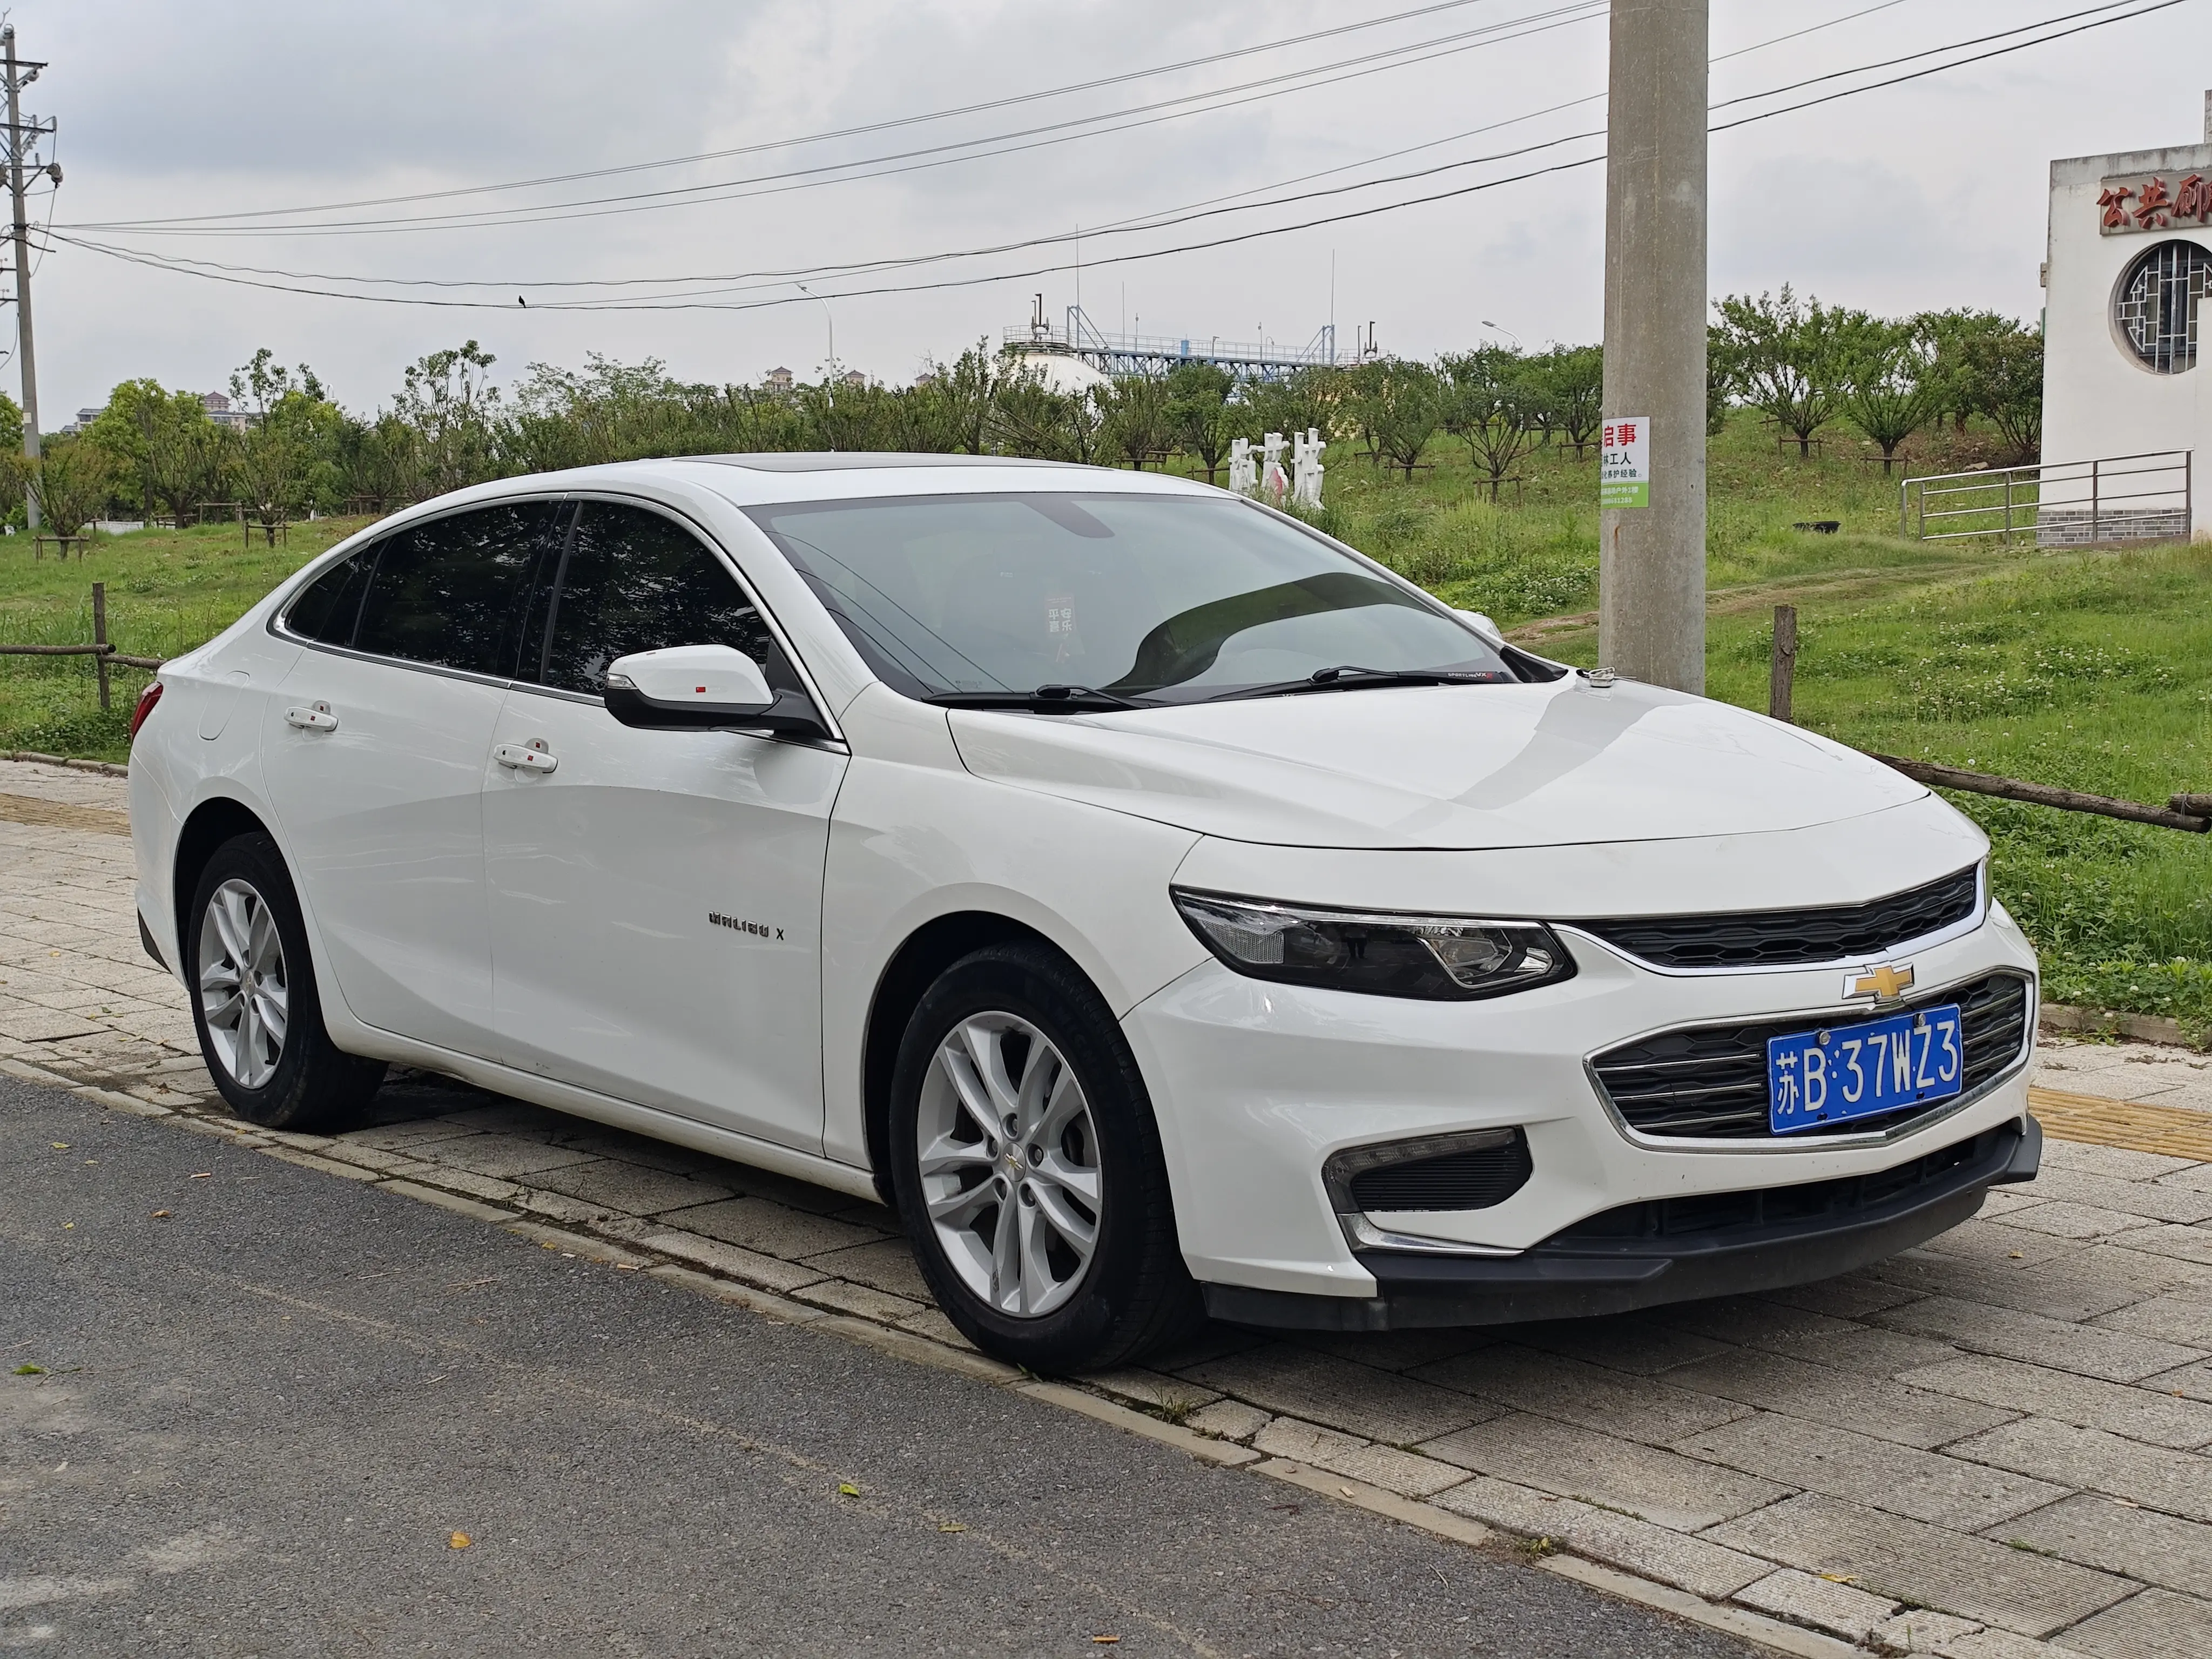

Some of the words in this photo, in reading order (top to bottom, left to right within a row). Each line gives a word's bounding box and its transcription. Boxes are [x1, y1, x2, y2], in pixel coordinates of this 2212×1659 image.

[2096, 173, 2212, 230] 公共厕
[1604, 423, 1636, 447] 启事
[1048, 608, 1072, 620] 平安
[1049, 620, 1073, 632] 喜乐
[709, 911, 769, 938] MALIBU
[776, 927, 784, 941] X
